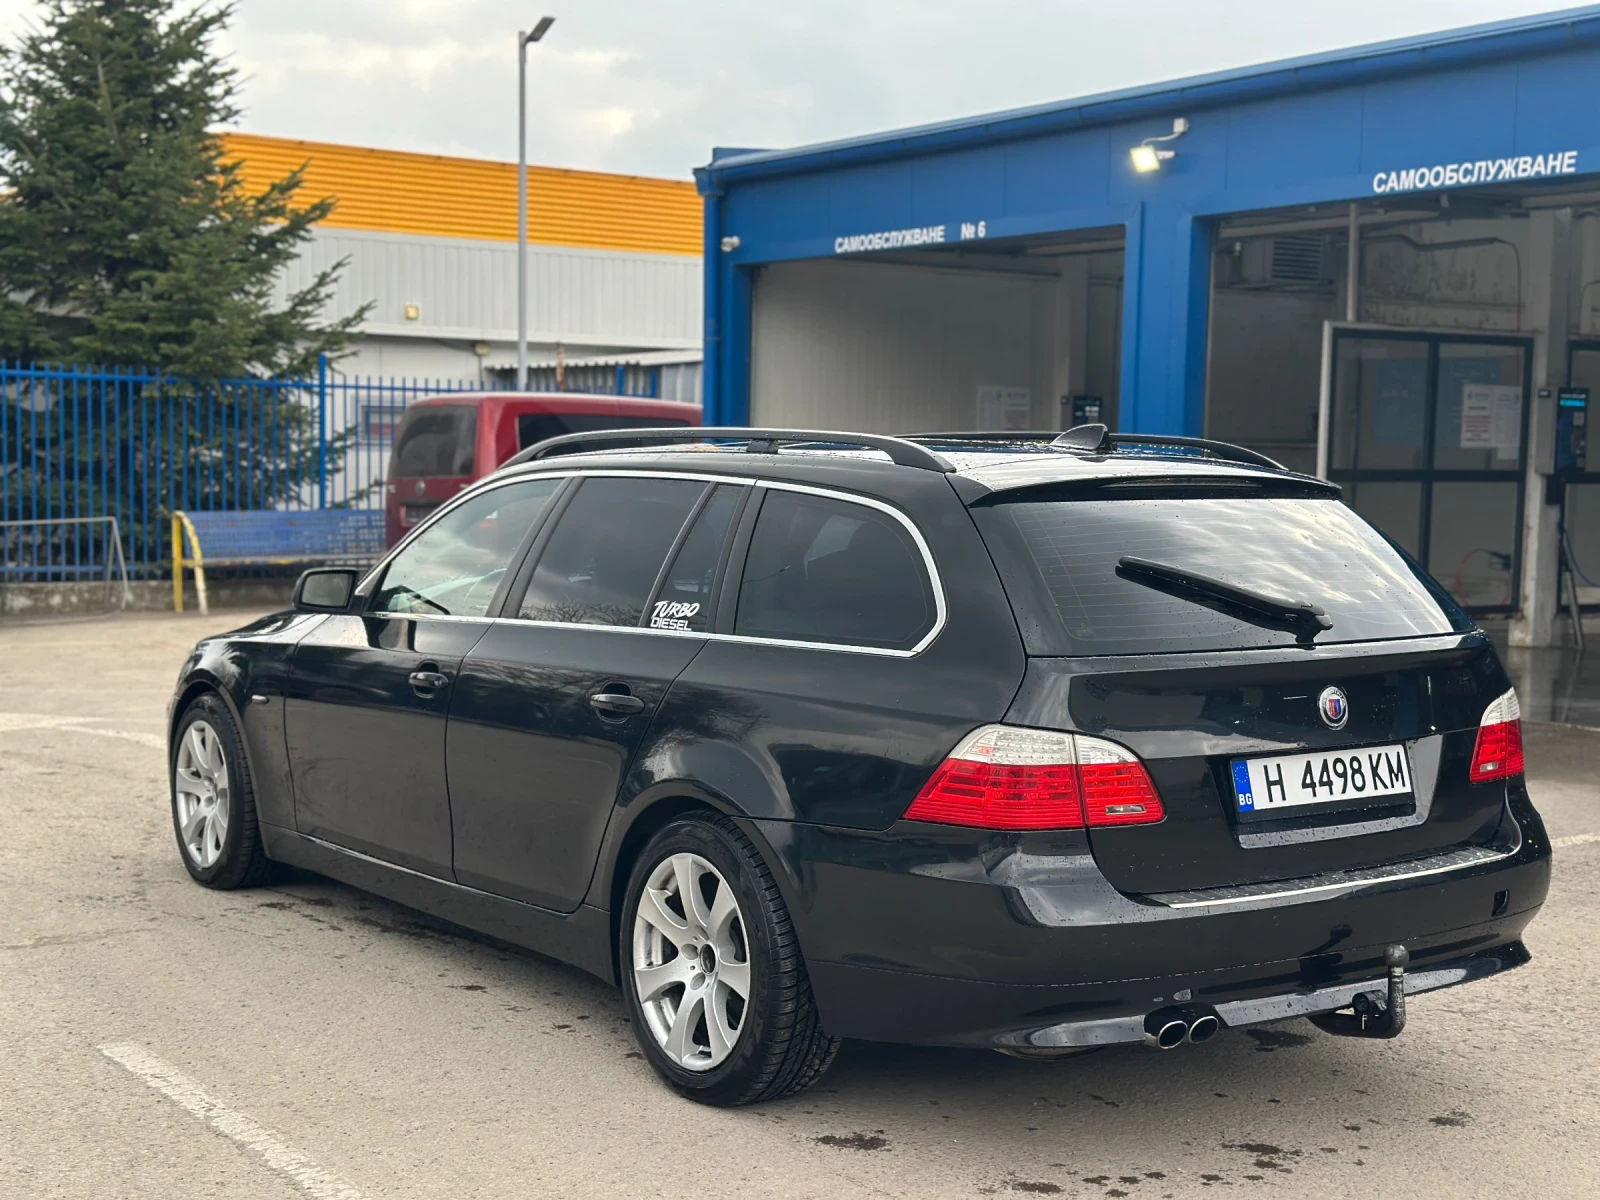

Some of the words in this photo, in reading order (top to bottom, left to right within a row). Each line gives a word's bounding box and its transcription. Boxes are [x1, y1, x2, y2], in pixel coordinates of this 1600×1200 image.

[1373, 151, 1578, 193] САМООБСЛУЖВАНЕ
[834, 225, 946, 254] САМООБСЛУЖВАНЕ
[651, 600, 700, 618] TURBO
[650, 617, 692, 631] DIESEL
[1263, 763, 1287, 803] H
[1301, 755, 1367, 798] 4498
[1368, 751, 1406, 791] KM
[1238, 793, 1253, 806] BG
